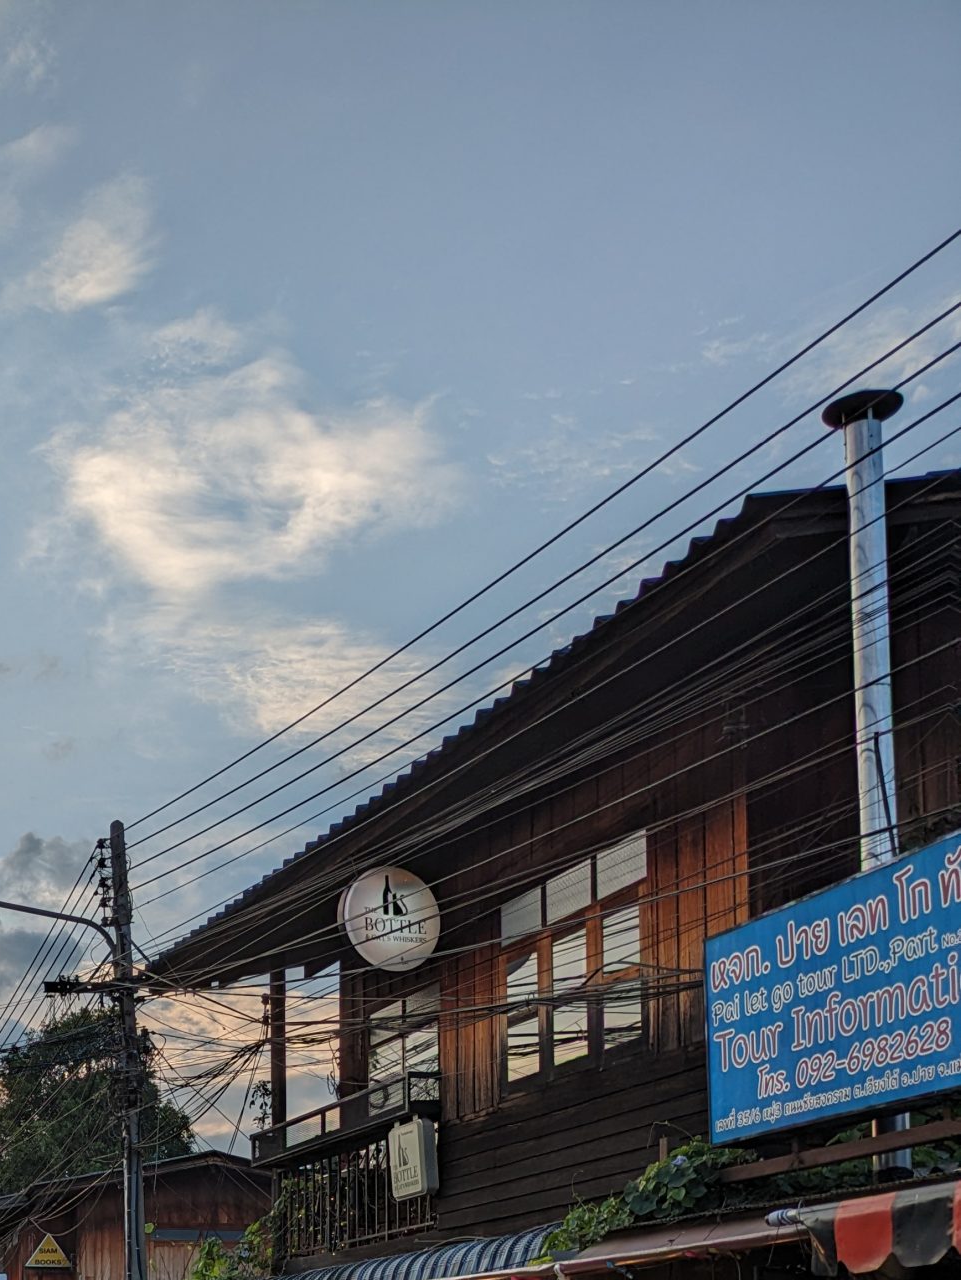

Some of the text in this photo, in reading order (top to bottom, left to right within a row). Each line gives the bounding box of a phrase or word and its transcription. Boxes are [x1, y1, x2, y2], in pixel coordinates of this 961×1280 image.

[364, 916, 427, 935] BOTTLE
[710, 943, 771, 993] หจก.
[775, 917, 832, 969] ปาย
[837, 894, 889, 947] เลท
[893, 864, 932, 925] โก
[712, 998, 740, 1027] Pai
[744, 986, 768, 1015] let
[772, 984, 794, 1013] go
[797, 963, 837, 998] tour
[713, 1020, 784, 1073] Tour
[756, 1016, 952, 1100] โทร. 092-6982628
[737, 1105, 761, 1128] 35/6
[393, 1164, 418, 1185] BOTTLE
[34, 1258, 62, 1266] BOOKS
[39, 1247, 58, 1255] SIAM
